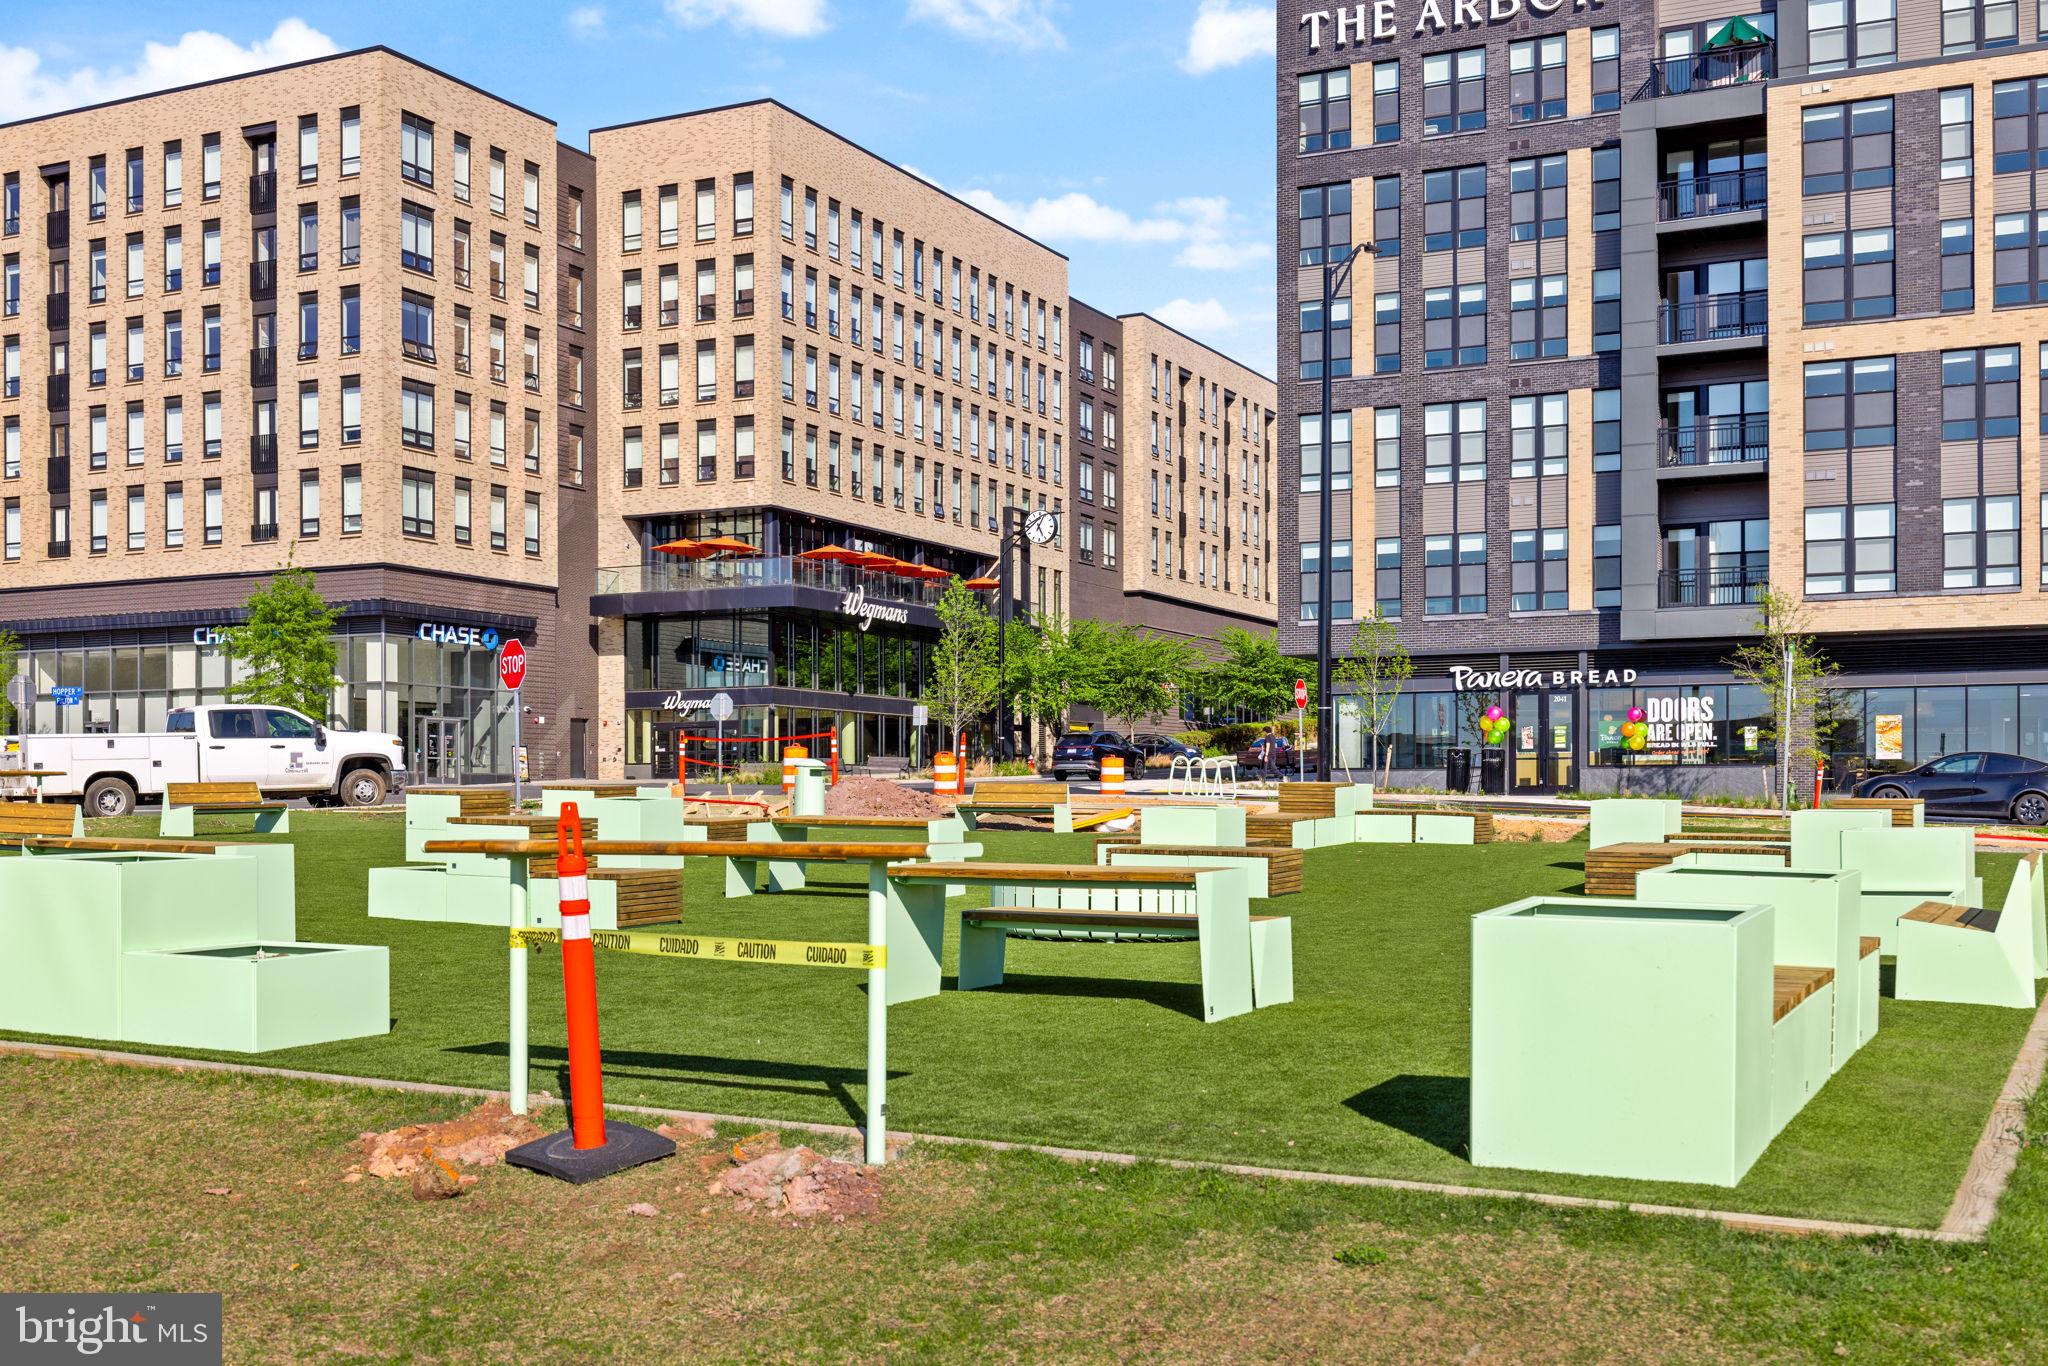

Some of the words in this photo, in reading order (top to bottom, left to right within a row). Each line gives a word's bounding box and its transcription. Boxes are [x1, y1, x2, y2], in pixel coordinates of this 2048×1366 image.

[1301, 0, 1398, 49] THE
[1415, 0, 1608, 31] ARB
[842, 585, 908, 631] Wegmans
[419, 623, 481, 646] CHASE
[502, 655, 524, 674] STOP
[1450, 666, 1543, 690] Panera
[1552, 669, 1637, 685] BREAD
[662, 691, 711, 717] Wegma
[1647, 696, 1714, 722] DOORS
[1647, 723, 1673, 741] ARE
[593, 933, 631, 950] CAUTION
[659, 937, 699, 955] CUIDADO
[737, 942, 776, 960] CAUTION
[806, 946, 847, 964] CUIDADO
